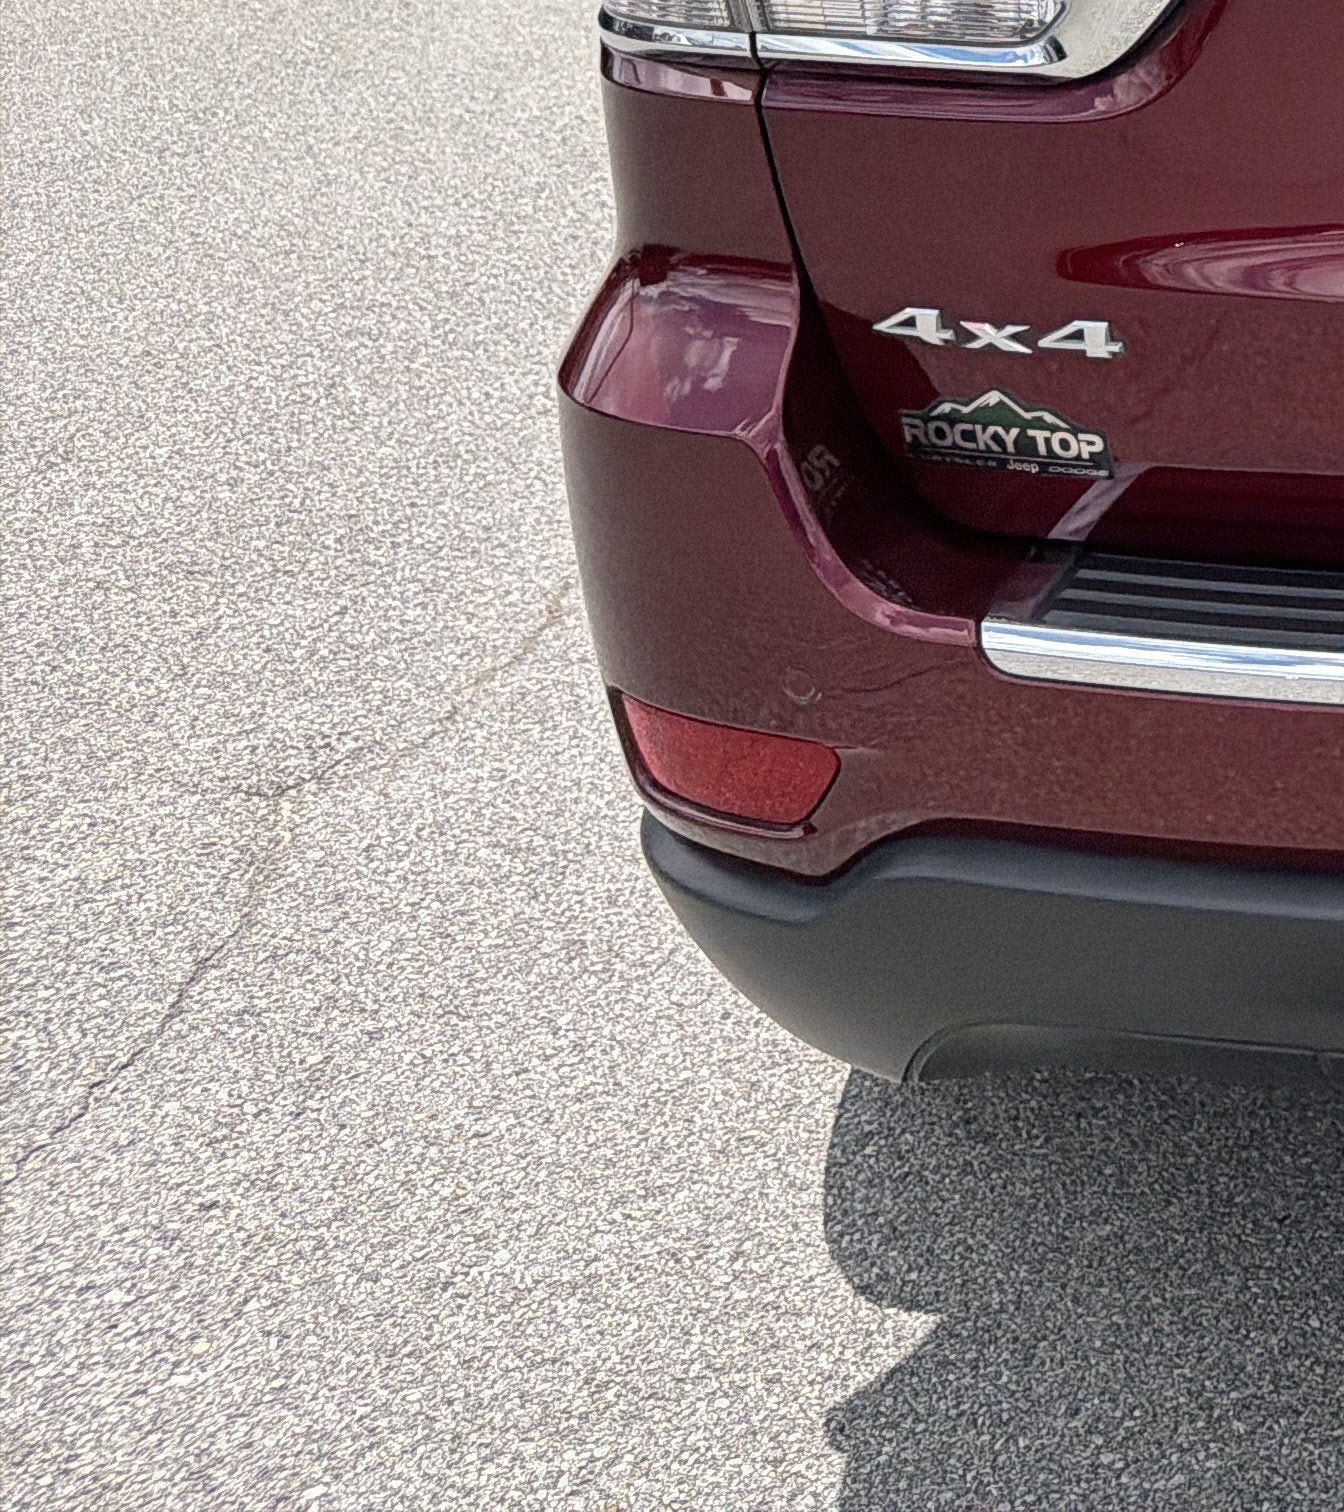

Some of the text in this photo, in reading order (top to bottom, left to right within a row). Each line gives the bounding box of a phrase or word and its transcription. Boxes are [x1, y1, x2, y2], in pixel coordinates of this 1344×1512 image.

[903, 417, 1105, 460] ROCKY TOP
[1006, 459, 1040, 474] Jeep
